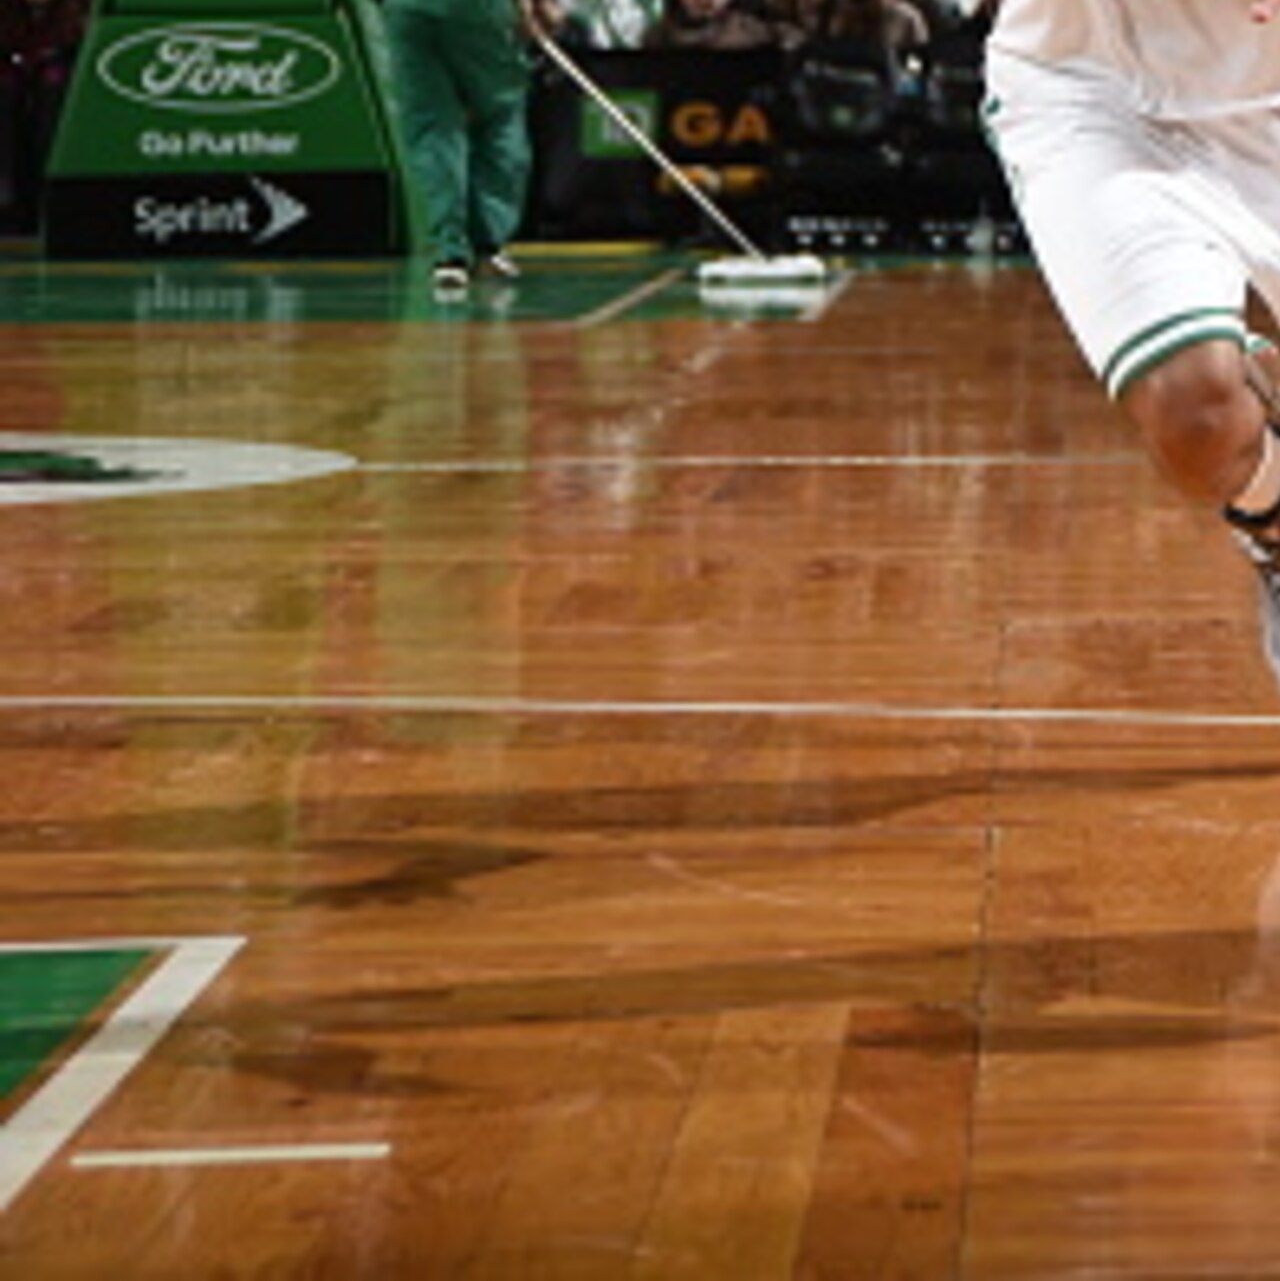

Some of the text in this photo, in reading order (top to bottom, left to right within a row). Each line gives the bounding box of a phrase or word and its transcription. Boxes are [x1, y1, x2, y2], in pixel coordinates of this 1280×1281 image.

[140, 33, 299, 95] Ford
[138, 130, 299, 157] Go Further
[133, 195, 251, 244] Sprint
